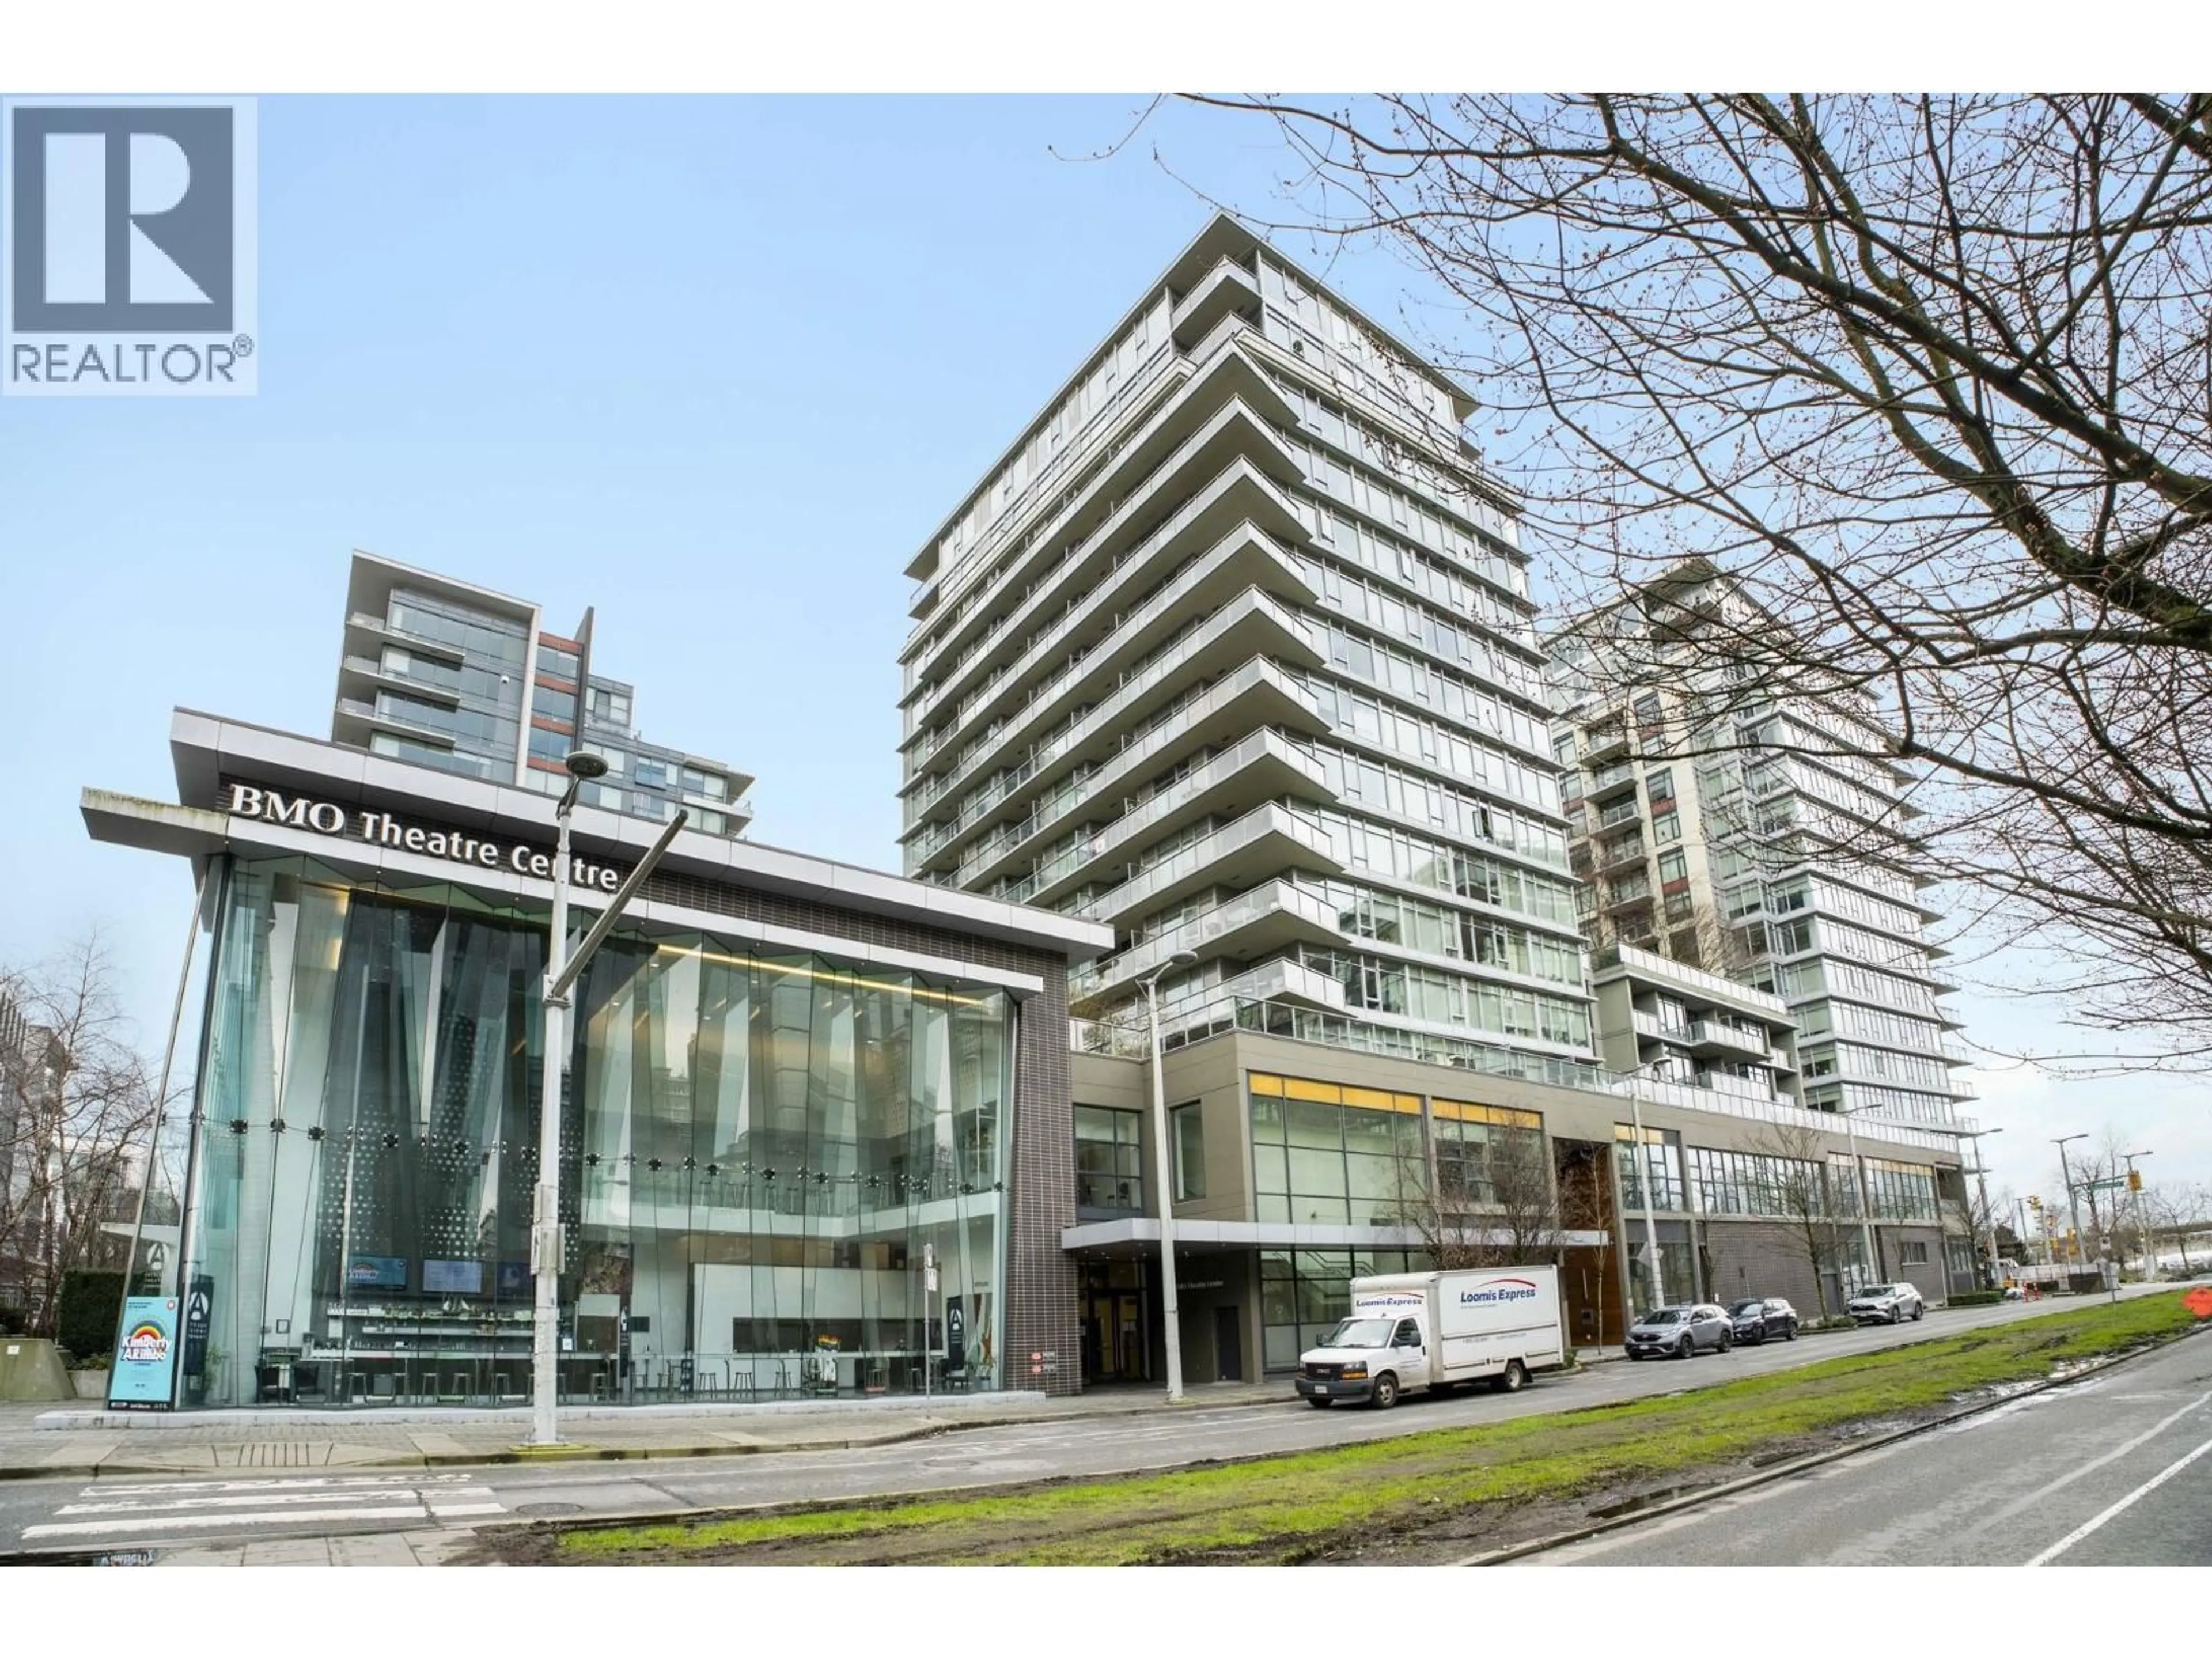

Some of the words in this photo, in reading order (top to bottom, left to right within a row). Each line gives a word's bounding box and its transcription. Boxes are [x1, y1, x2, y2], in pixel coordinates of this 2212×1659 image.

[229, 783, 345, 832] BMO
[361, 812, 499, 865] Theatre
[512, 845, 618, 889] Cetre
[1387, 1298, 1422, 1306] Express
[1460, 1290, 1497, 1302] Loomis
[1498, 1289, 1536, 1301] Express
